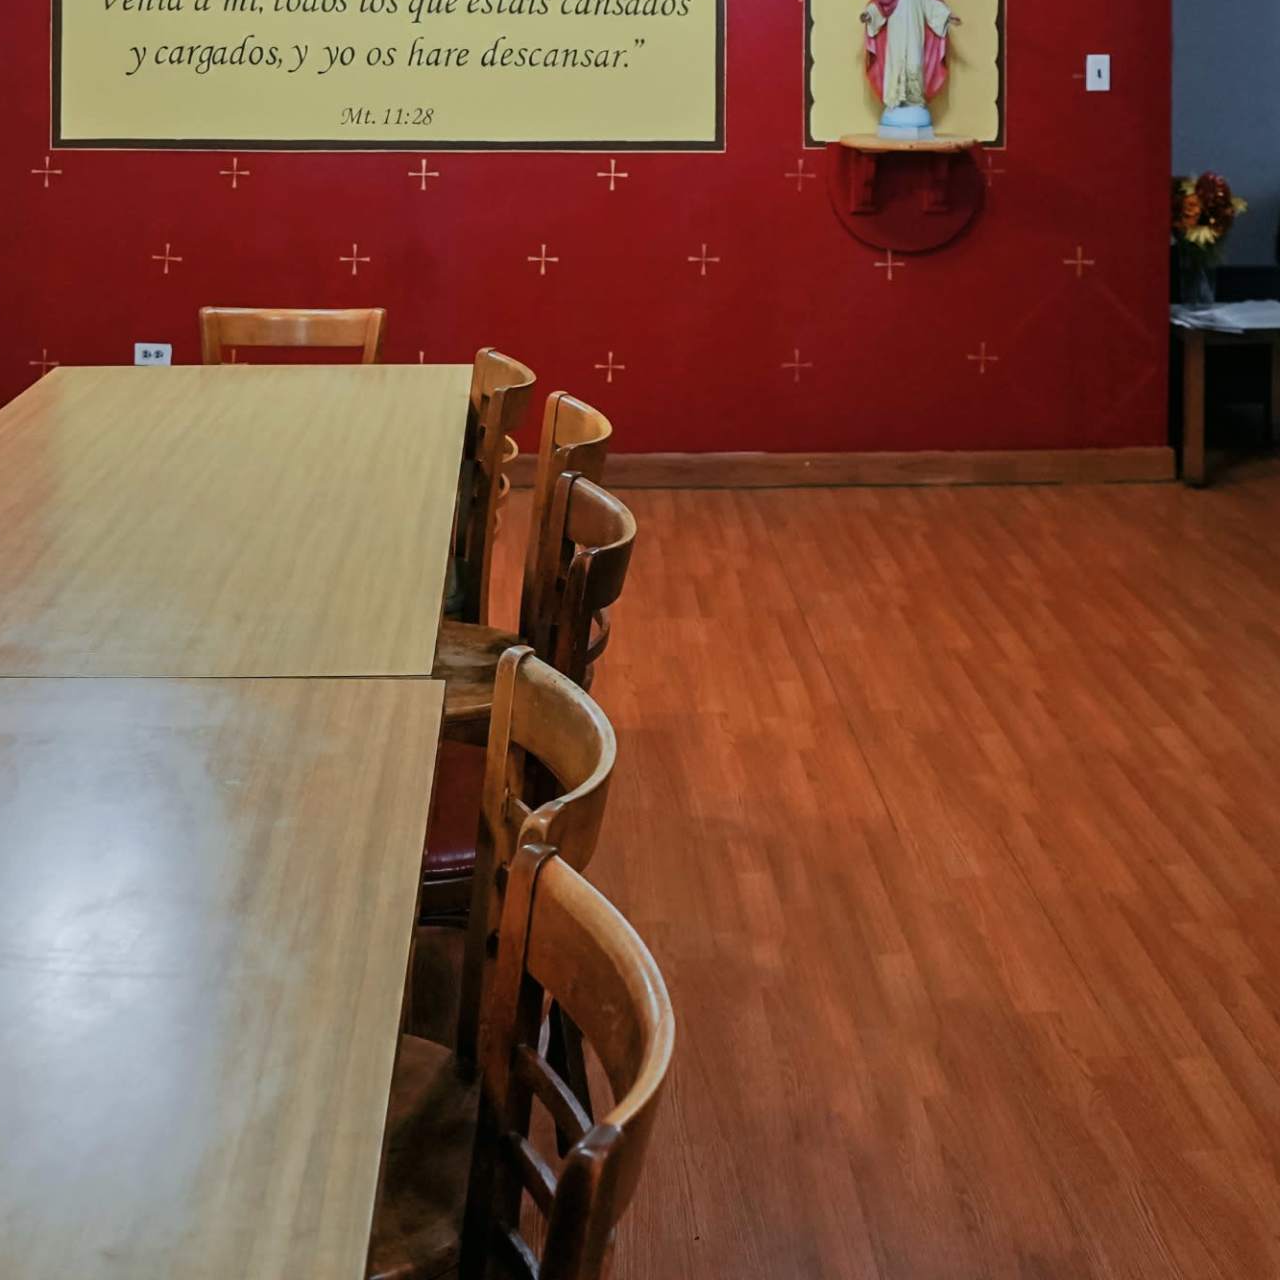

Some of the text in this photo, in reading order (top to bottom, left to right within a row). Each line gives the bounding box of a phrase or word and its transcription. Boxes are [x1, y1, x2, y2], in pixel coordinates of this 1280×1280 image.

[124, 33, 646, 77] y cargados, y yo os hare descansar.”
[340, 107, 435, 126] Mt. 11:28
